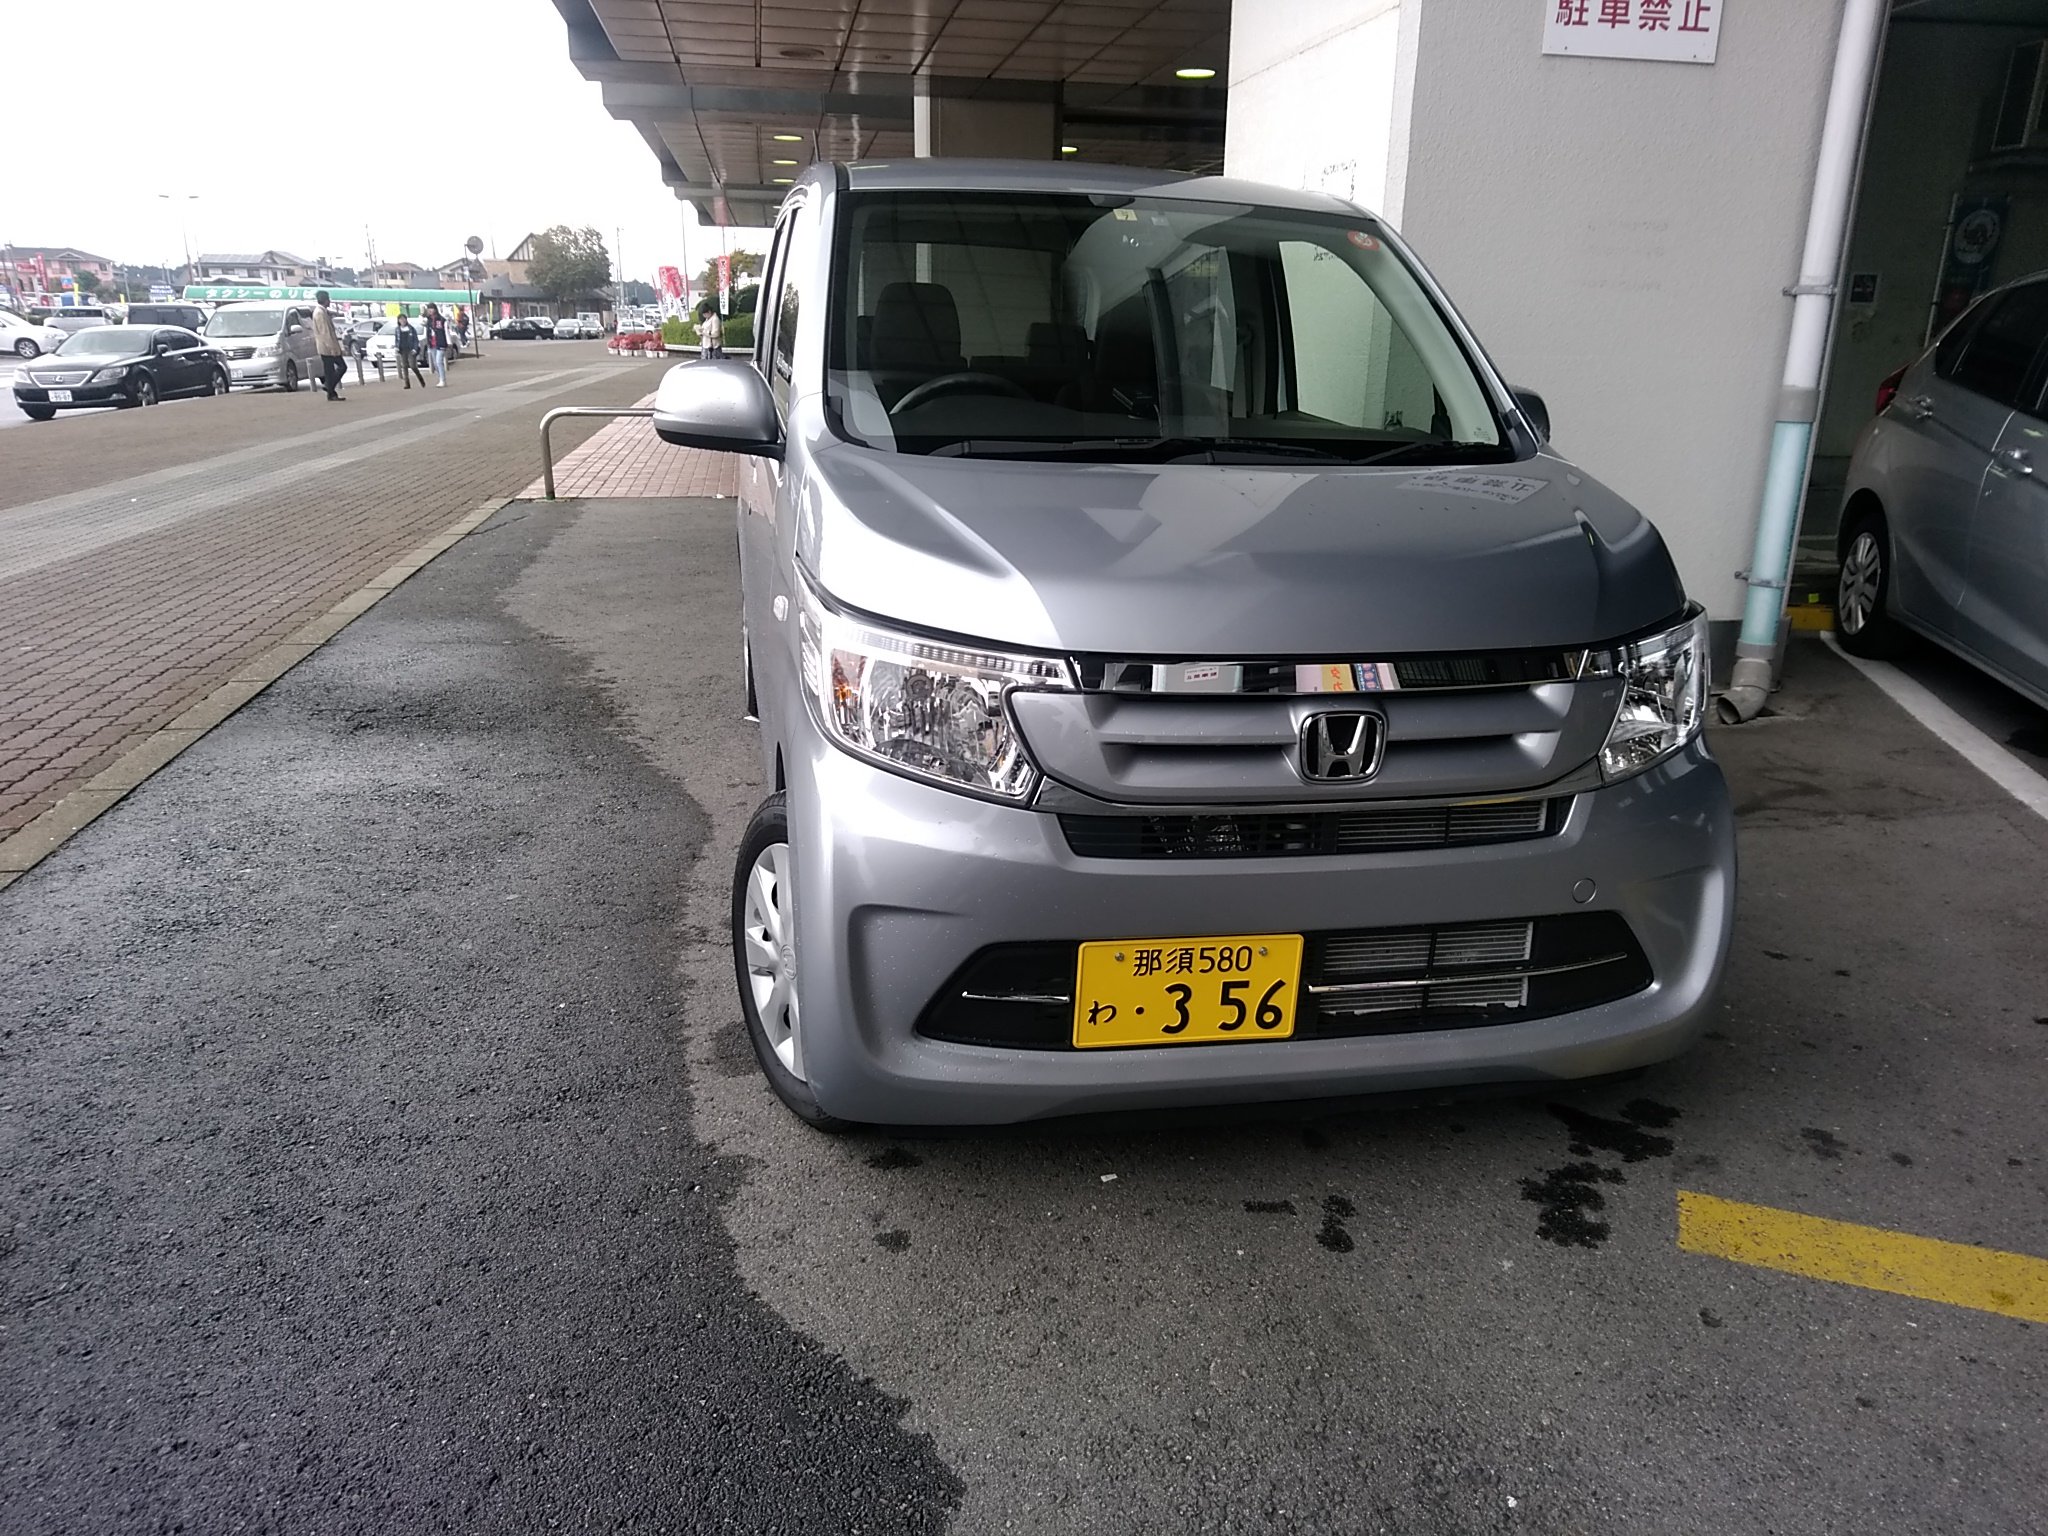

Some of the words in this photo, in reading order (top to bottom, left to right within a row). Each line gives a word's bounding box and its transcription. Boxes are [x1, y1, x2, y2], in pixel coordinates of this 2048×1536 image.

[1556, 0, 1711, 32] 駐車禁止
[206, 288, 317, 298] タクシーのりば
